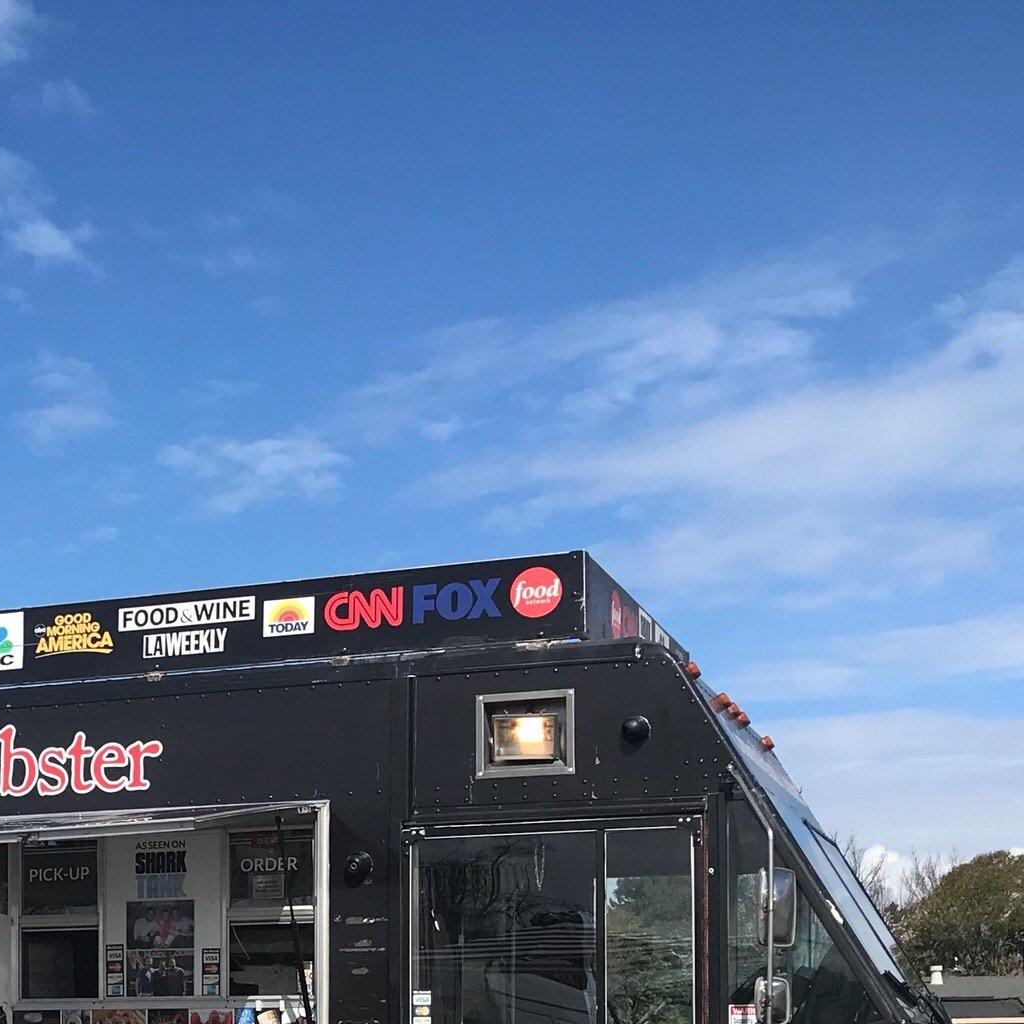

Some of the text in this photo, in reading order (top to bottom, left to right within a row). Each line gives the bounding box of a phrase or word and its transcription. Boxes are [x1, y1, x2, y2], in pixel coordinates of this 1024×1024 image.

[514, 574, 559, 609] food
[325, 586, 403, 631] CNN
[413, 577, 502, 624] FOX
[55, 612, 91, 626] GOOD
[47, 621, 100, 637] MORNING
[268, 621, 309, 634] TODAY
[35, 632, 114, 654] AMERICA
[135, 840, 186, 850] AS SEEN ON
[134, 850, 187, 875] SHARK
[240, 857, 298, 873] ORDER
[29, 866, 90, 882] PICK-UP
